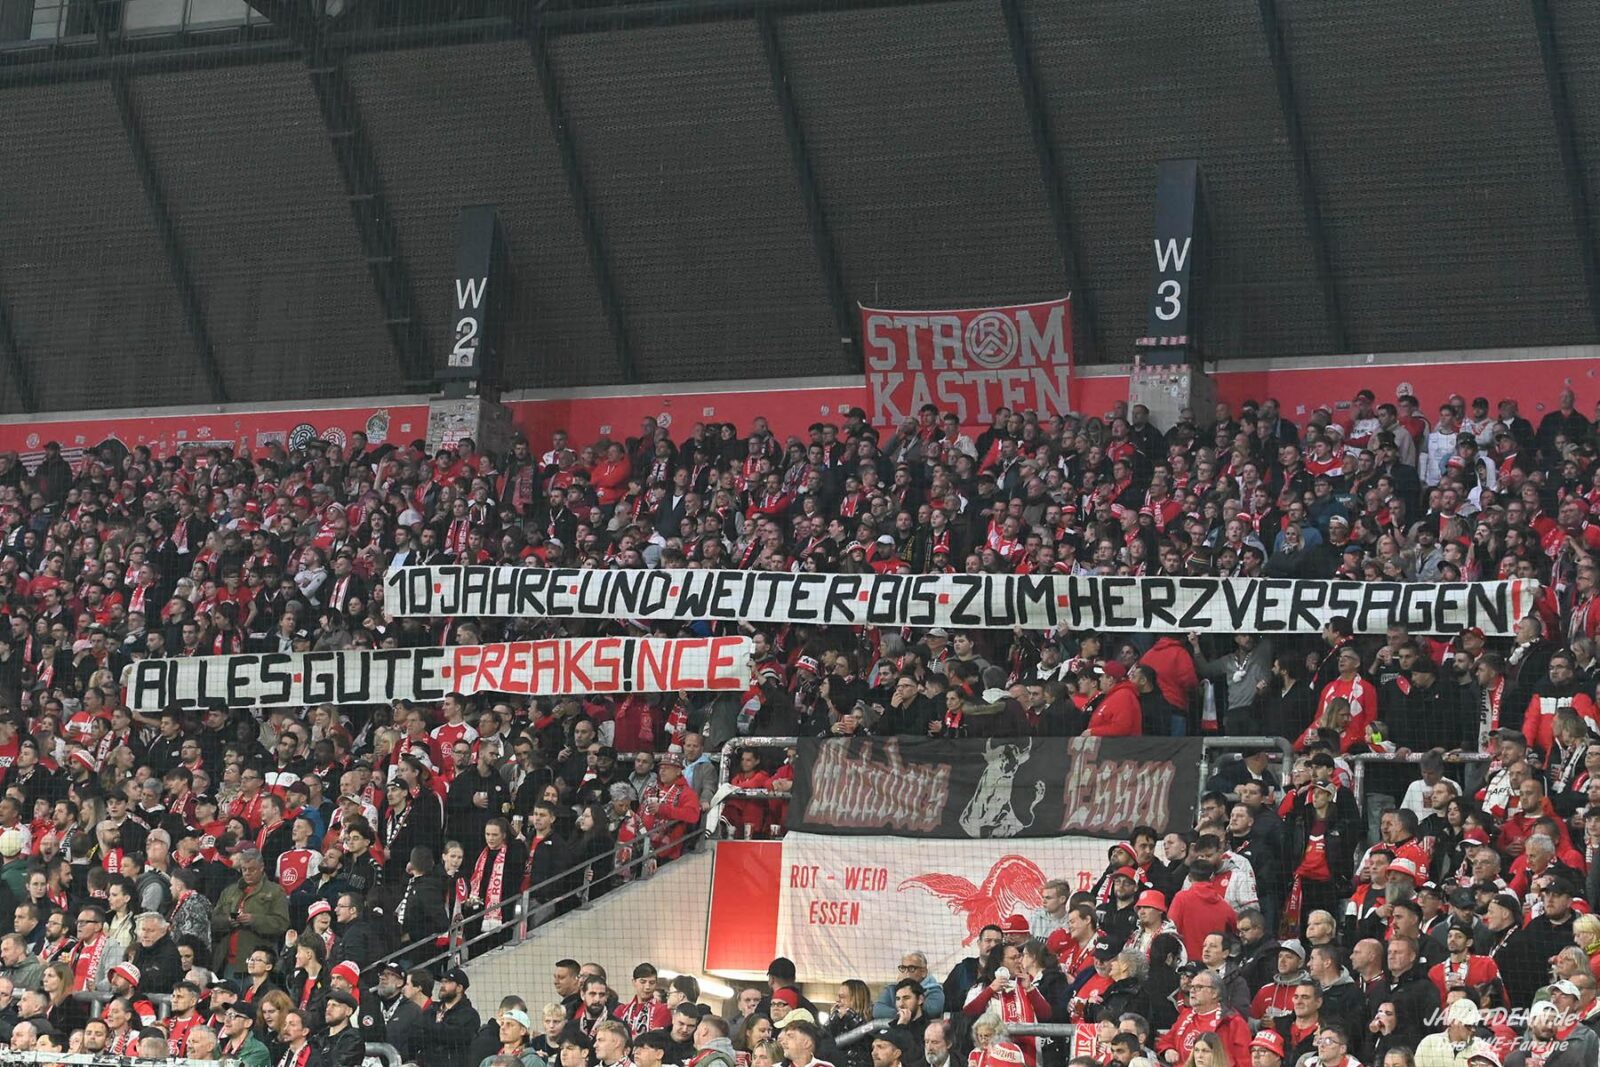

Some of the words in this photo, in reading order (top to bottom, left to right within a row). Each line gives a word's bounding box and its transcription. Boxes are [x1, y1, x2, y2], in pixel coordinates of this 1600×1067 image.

[1154, 237, 1191, 272] W
[456, 277, 487, 309] W
[1155, 280, 1181, 321] 3
[453, 317, 478, 354] 2
[869, 366, 1070, 427] KASTEN
[438, 566, 579, 615] JAHRE
[578, 570, 671, 616] UND
[675, 571, 862, 622] WEITER
[950, 575, 1057, 626] ZUM
[134, 654, 292, 710] ALLES
[302, 648, 445, 704] GUTE
[1062, 736, 1175, 830] Essen
[790, 864, 820, 889] ROT
[809, 901, 860, 926] ESSEN
